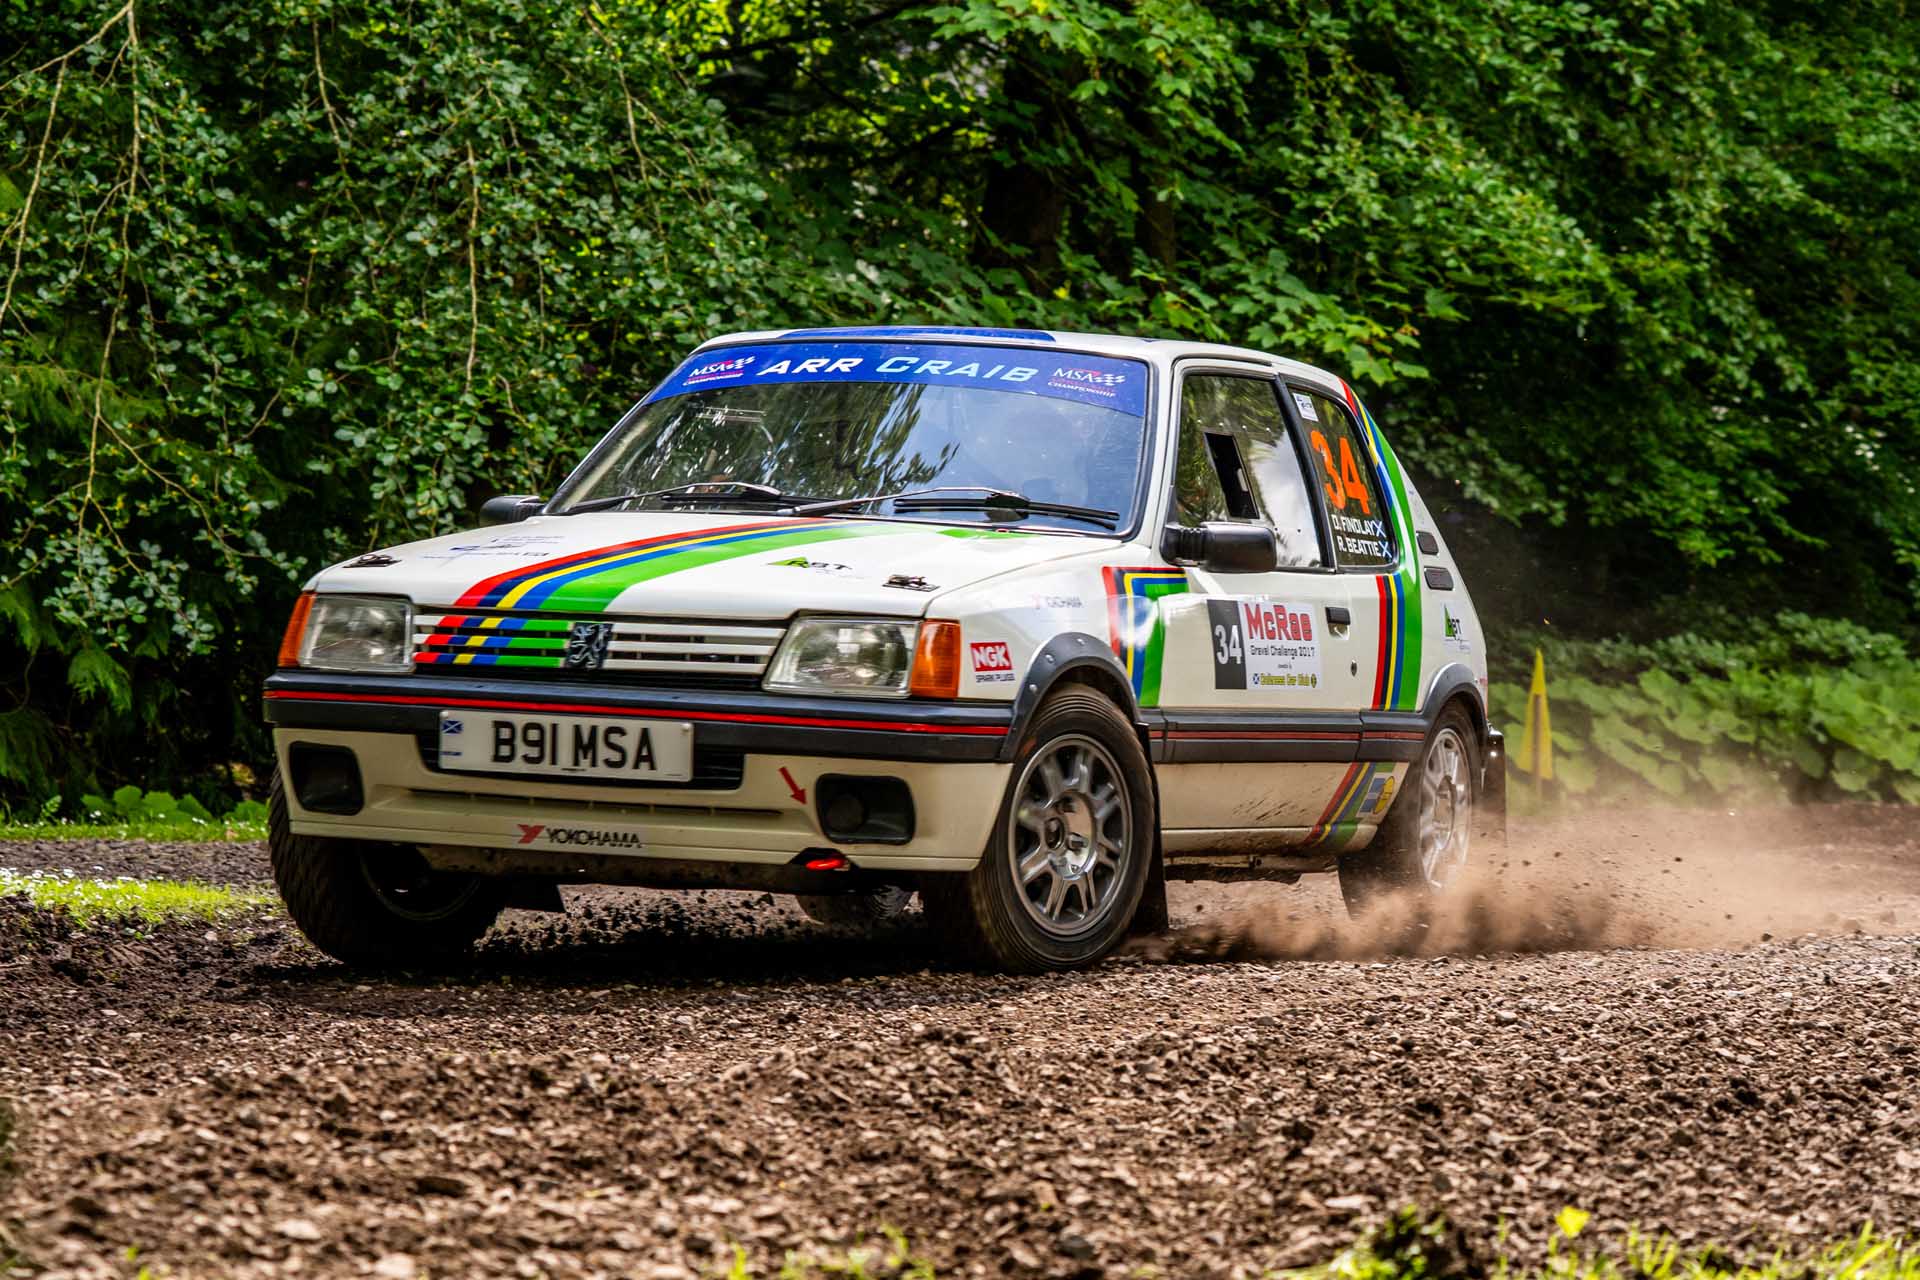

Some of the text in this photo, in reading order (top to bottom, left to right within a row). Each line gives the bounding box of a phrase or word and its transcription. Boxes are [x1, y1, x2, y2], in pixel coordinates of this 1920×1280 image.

[688, 362, 725, 378] MSA
[756, 358, 863, 376] ARR
[876, 356, 1038, 382] CRAIB
[1052, 367, 1094, 383] MSA
[1310, 430, 1371, 515] 34
[1331, 513, 1376, 537] D. FINDLAY
[1337, 535, 1383, 557] R. BEATTIE
[1244, 603, 1313, 641] McRae
[1214, 624, 1242, 664] 34
[1250, 644, 1315, 660] Gravel Challenge 2017
[972, 645, 1009, 668] NGK
[492, 720, 657, 771] B91 MSA
[546, 828, 643, 848] YOKOHAMA
